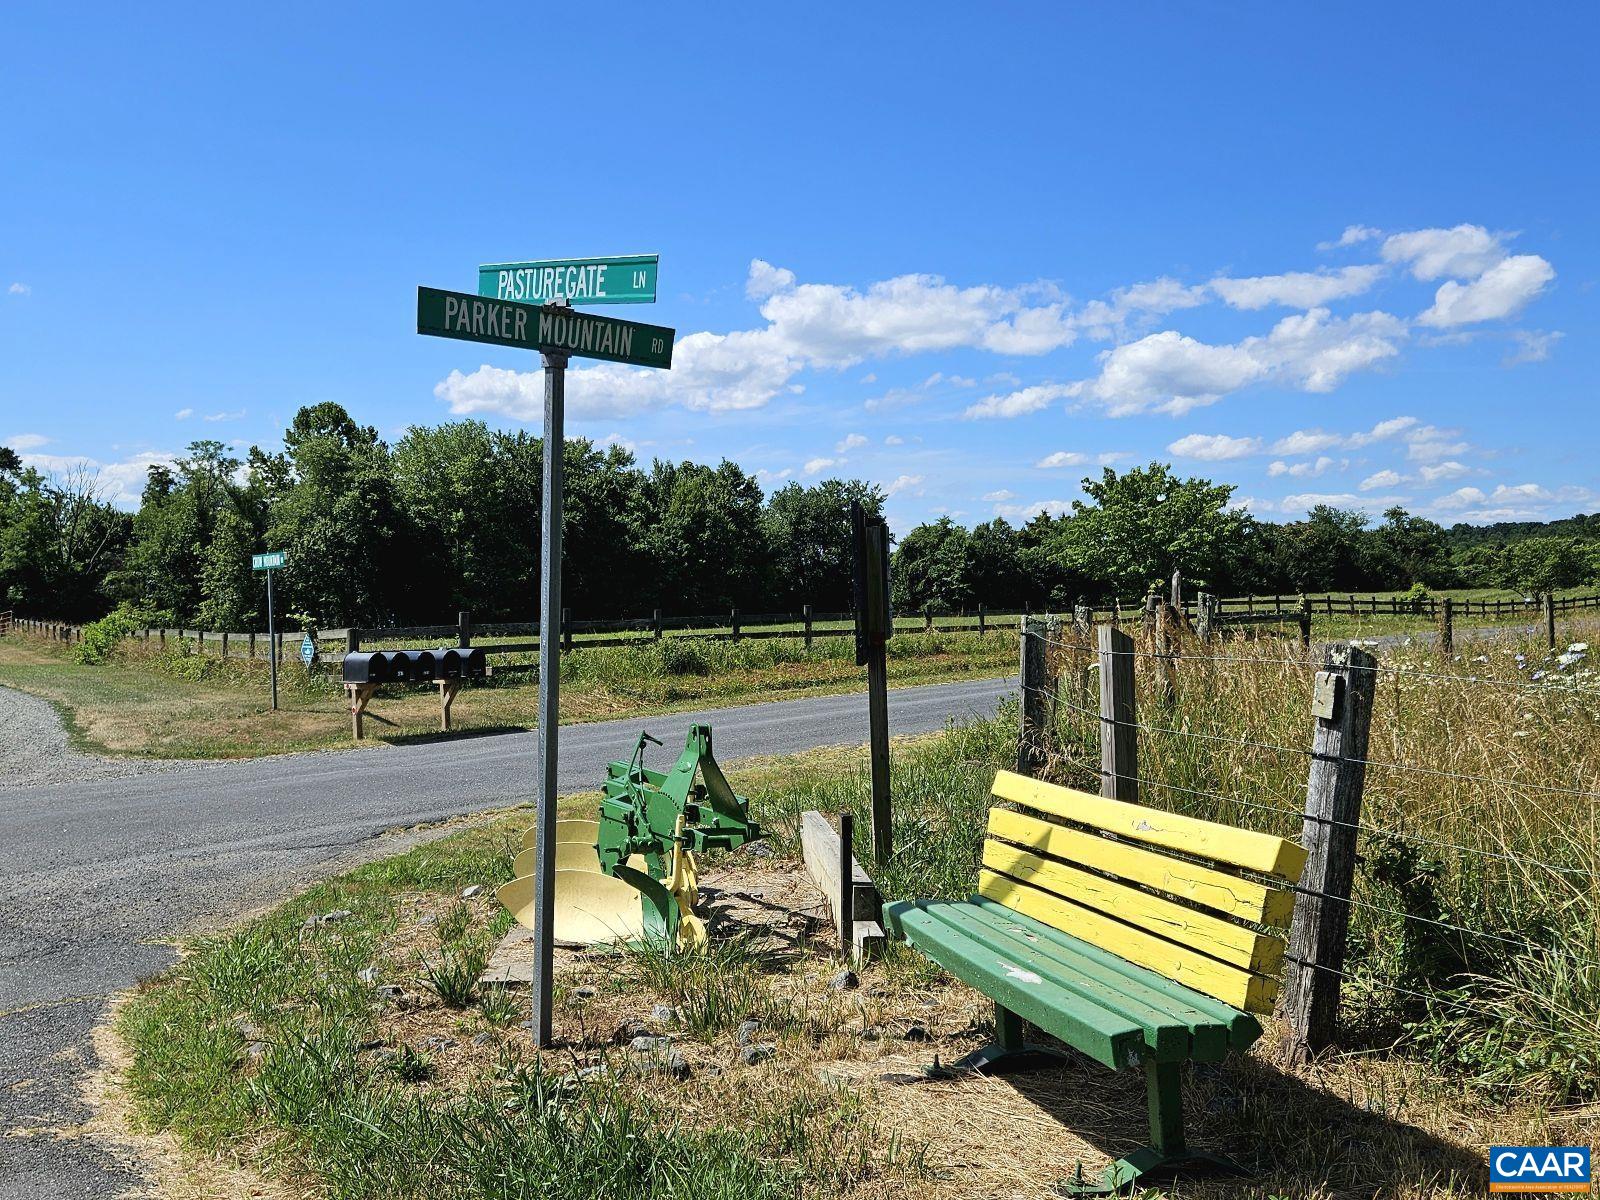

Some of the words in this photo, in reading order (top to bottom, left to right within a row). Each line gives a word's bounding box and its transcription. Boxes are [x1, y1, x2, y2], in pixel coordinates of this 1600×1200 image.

[498, 264, 608, 299] PASTUREGATE
[632, 271, 646, 289] LN
[444, 296, 527, 341] PARKER
[538, 312, 634, 357] MOUNTAIN
[651, 337, 664, 354] RD
